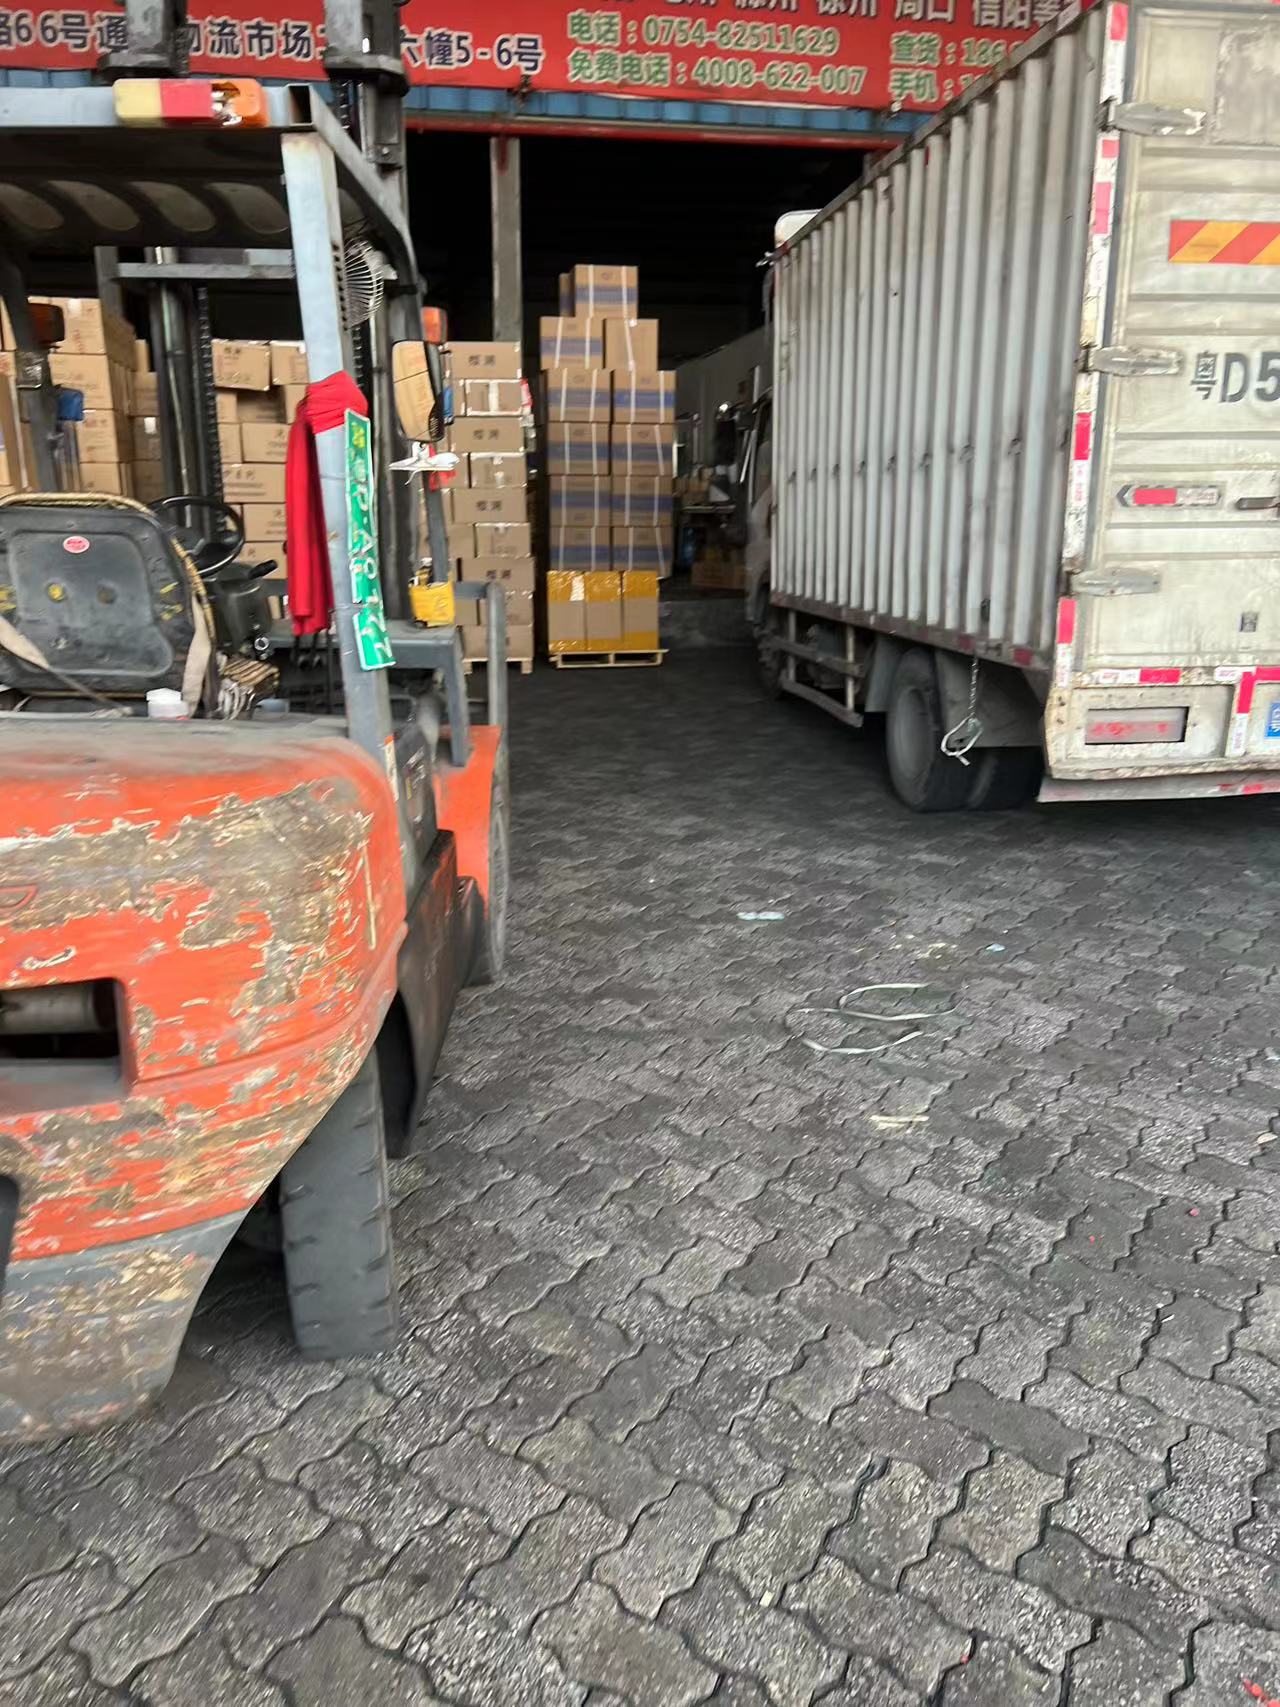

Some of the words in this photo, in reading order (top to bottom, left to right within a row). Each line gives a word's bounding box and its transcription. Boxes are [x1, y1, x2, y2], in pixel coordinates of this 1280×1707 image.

[890, 31, 1021, 67] 查货：186
[567, 49, 868, 95] 免费电话：4008-622-007
